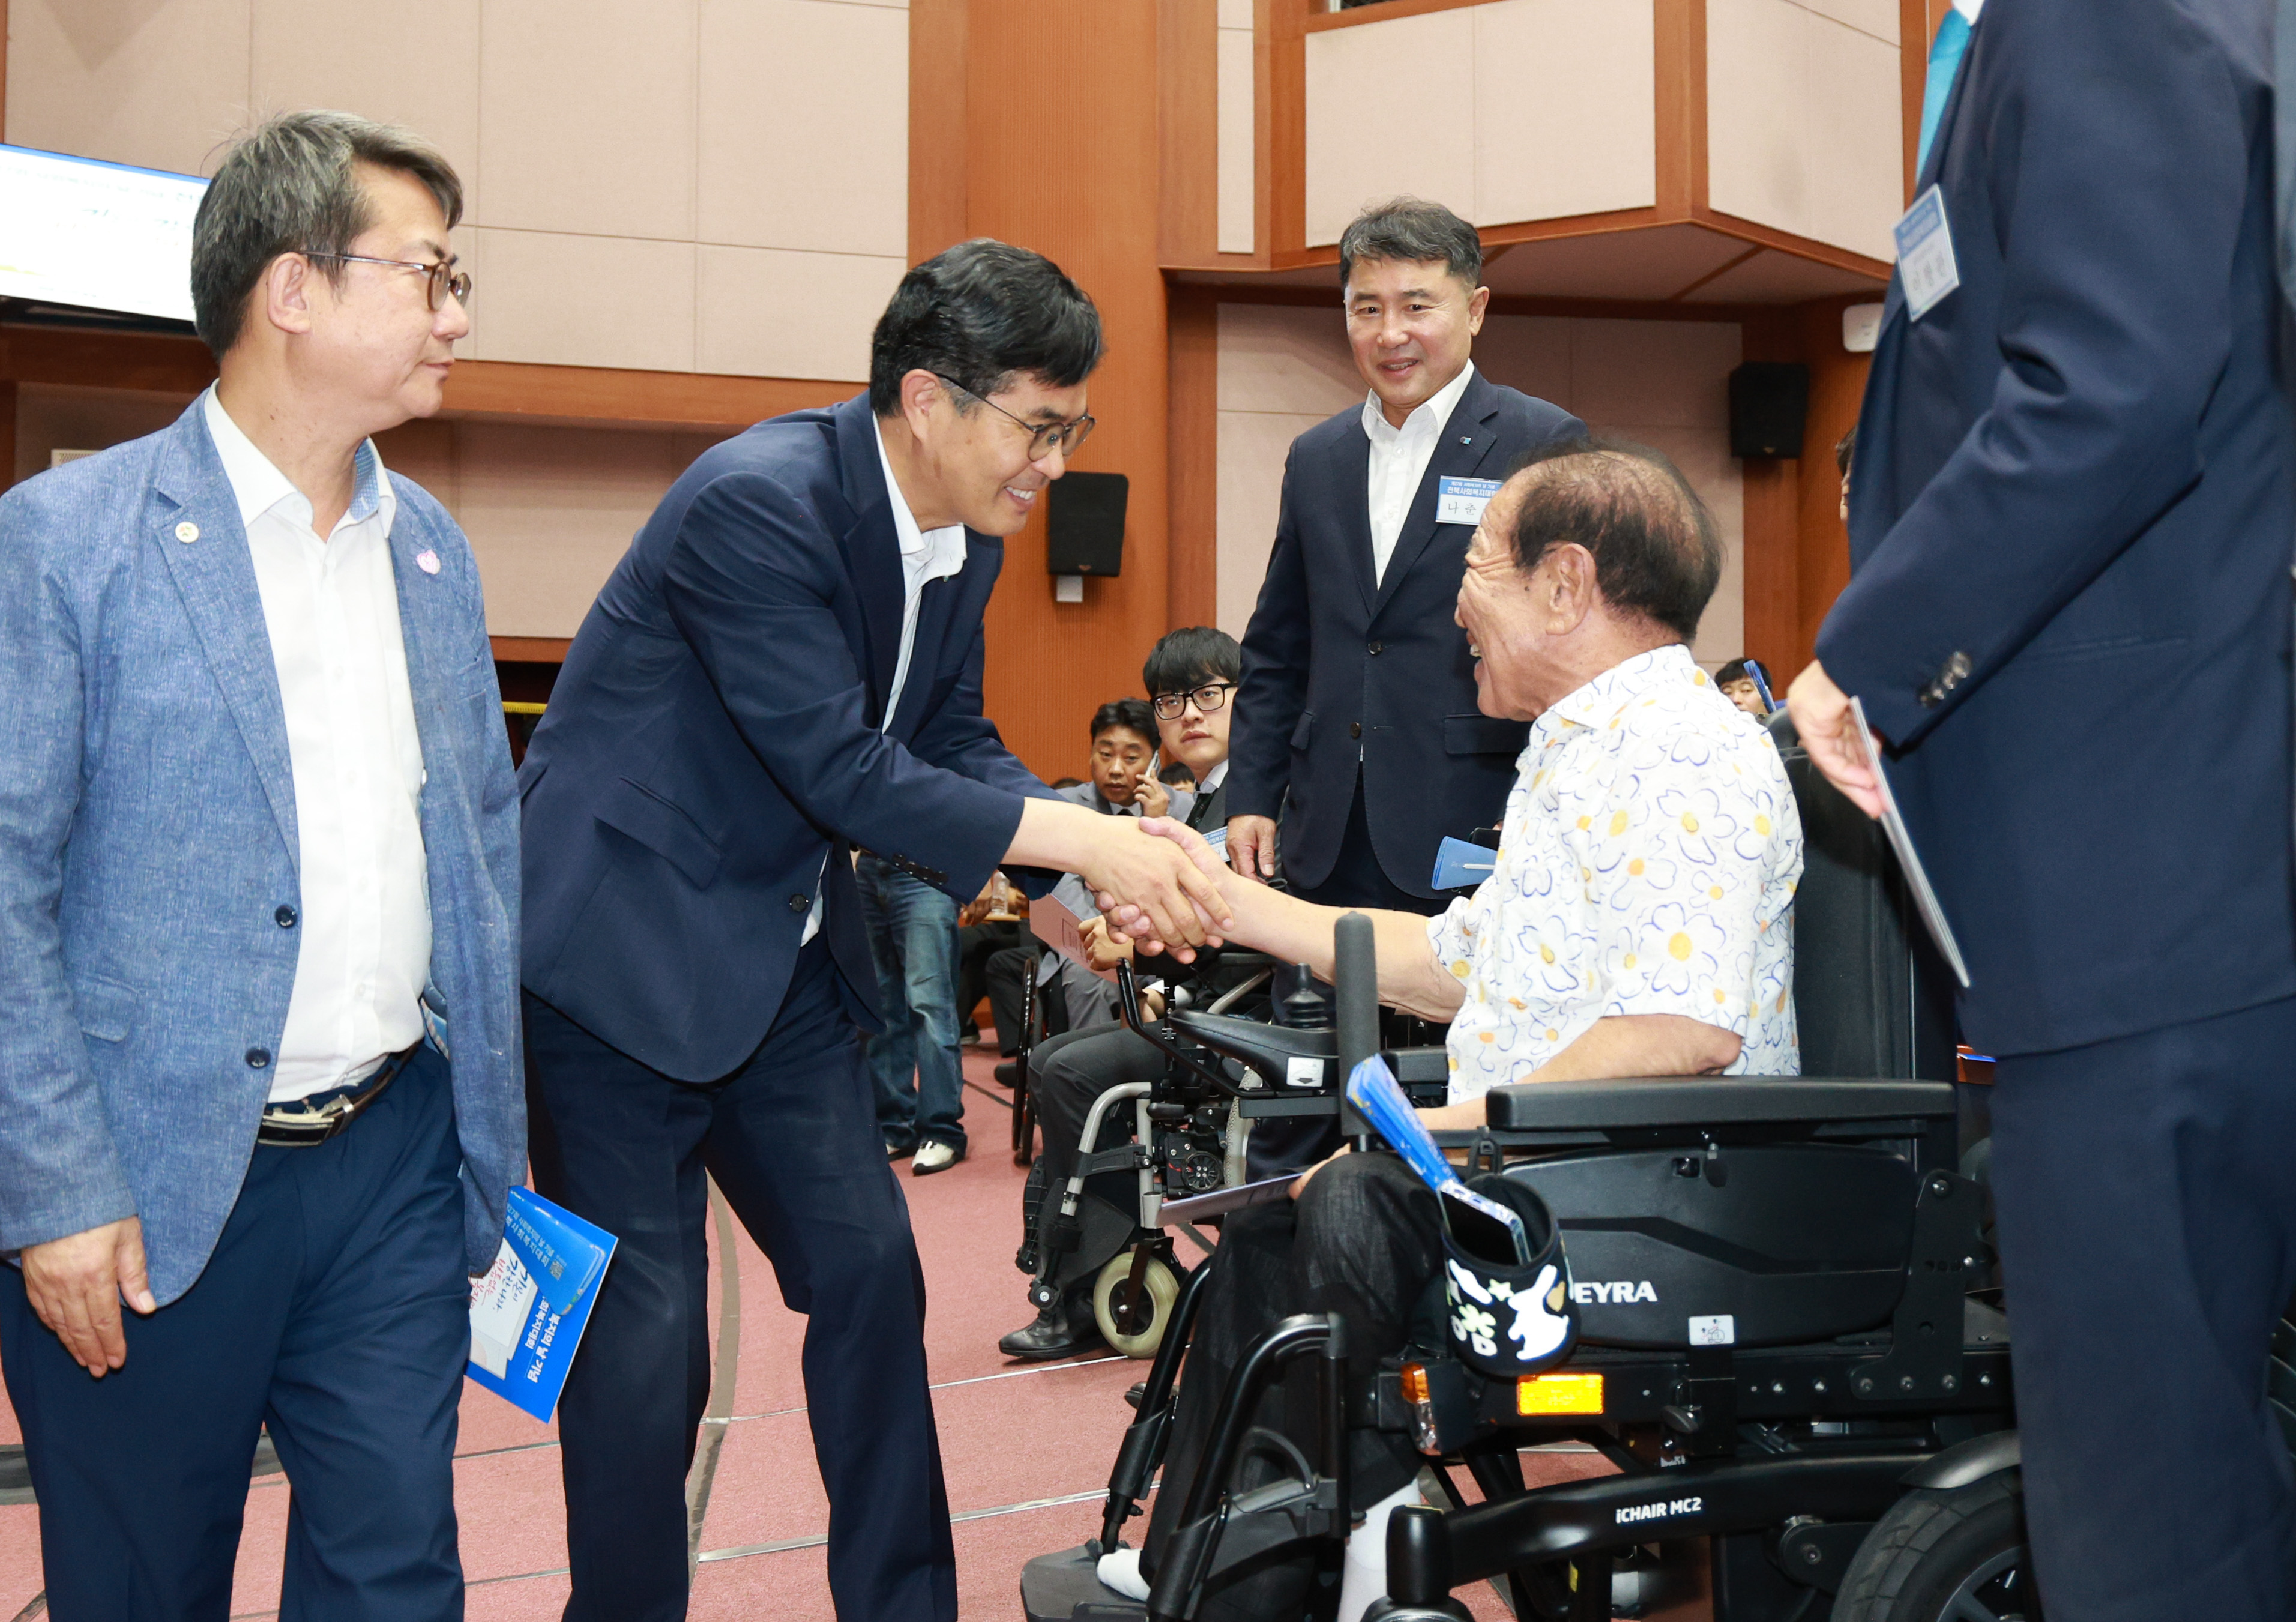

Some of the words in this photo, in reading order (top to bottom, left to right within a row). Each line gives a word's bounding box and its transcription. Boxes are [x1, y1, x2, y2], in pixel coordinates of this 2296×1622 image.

[1574, 1280, 1658, 1304] EYRA
[525, 1296, 550, 1349] 회복지대회
[535, 1345, 549, 1360] 날
[527, 1358, 544, 1383] 기념
[1615, 1502, 1667, 1524] iCHAIR
[1669, 1497, 1702, 1515] MC2
